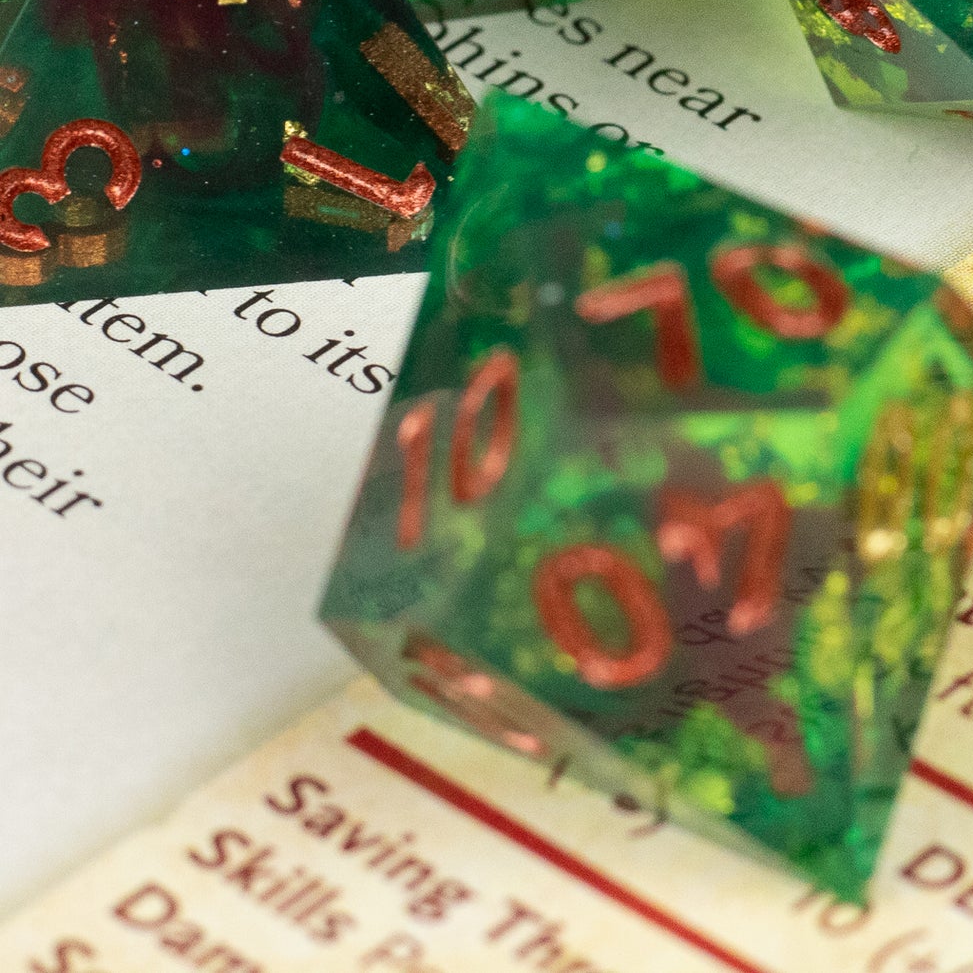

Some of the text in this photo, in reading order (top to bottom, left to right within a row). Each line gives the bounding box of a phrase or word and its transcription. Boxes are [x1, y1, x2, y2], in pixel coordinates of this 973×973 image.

[603, 40, 763, 132] near
[0, 118, 142, 253] 3
[233, 288, 399, 395] to its
[576, 240, 850, 389] 70
[186, 827, 360, 945] Skills
[263, 772, 476, 923] Saving
